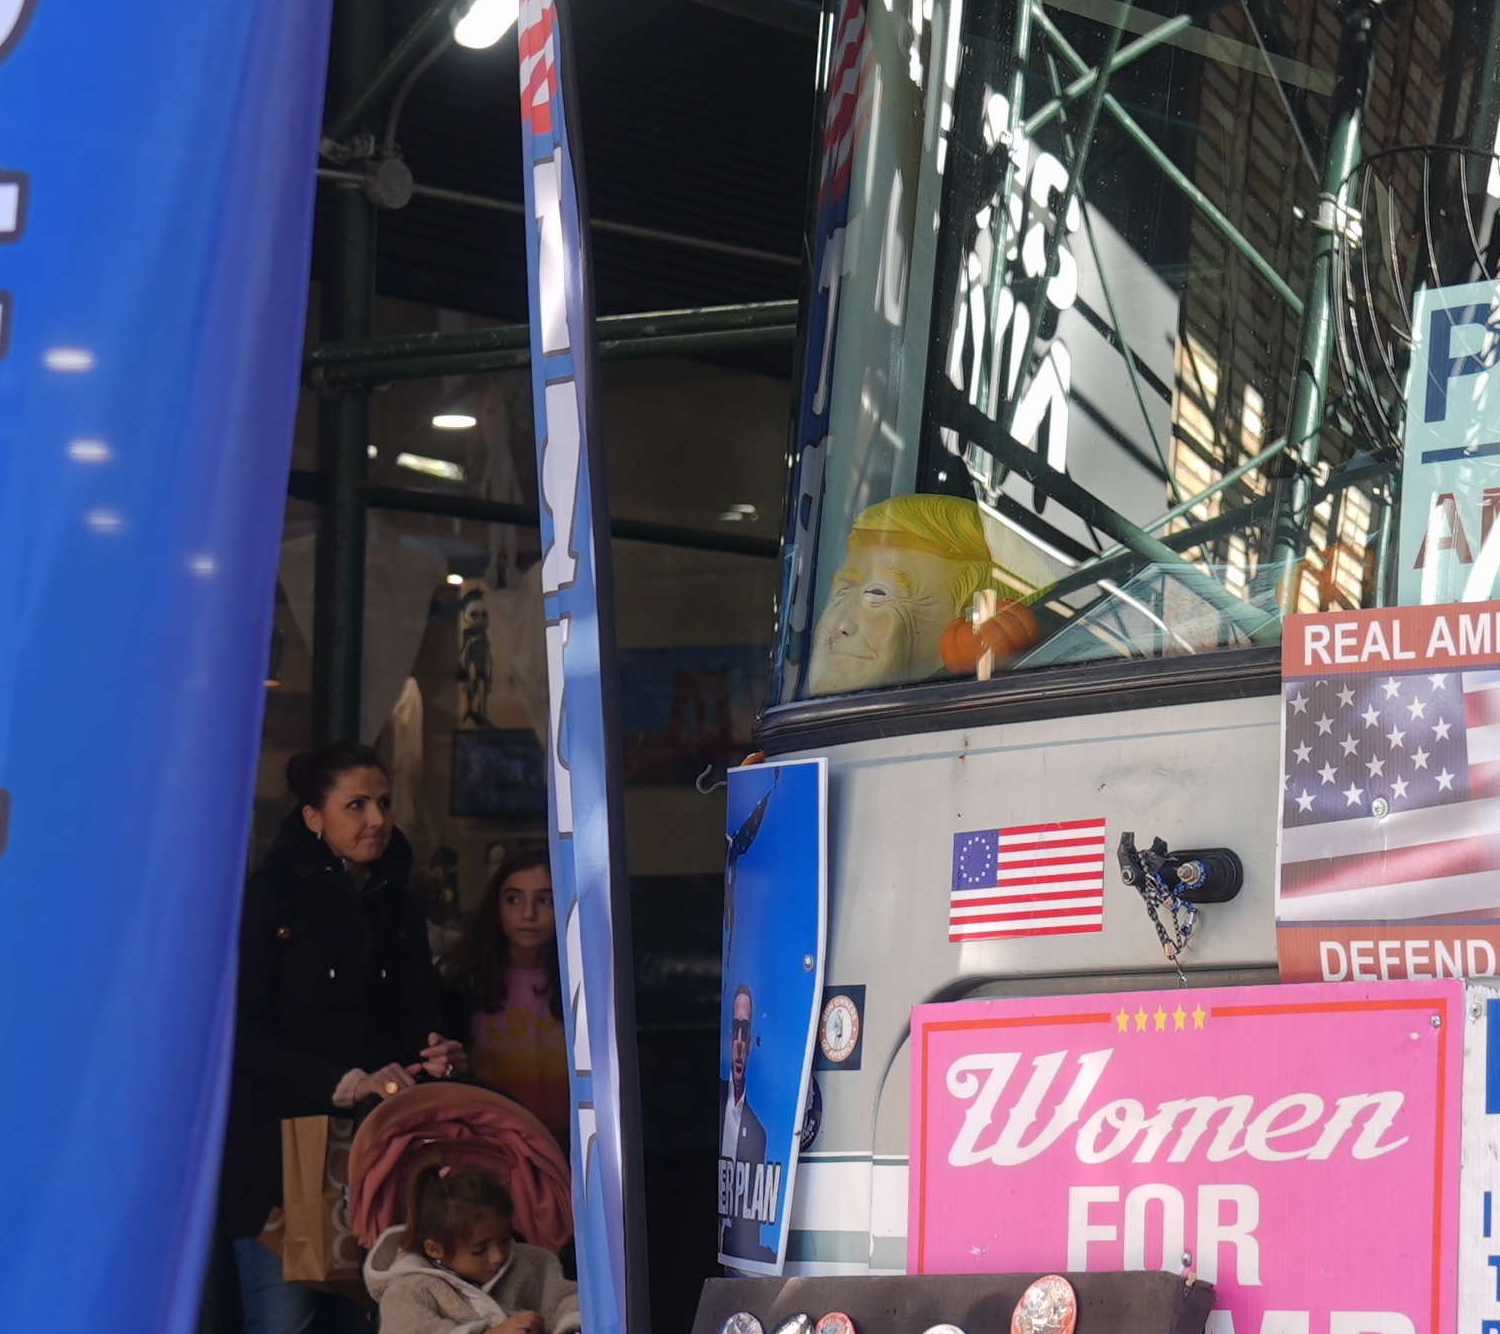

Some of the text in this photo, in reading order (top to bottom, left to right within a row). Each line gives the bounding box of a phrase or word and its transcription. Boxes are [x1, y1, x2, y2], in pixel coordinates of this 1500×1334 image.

[1302, 613, 1416, 665] REAL
[1319, 938, 1497, 983] DEFEND
[946, 1048, 1409, 1167] Women
[735, 1163, 782, 1223] PLAN
[1483, 1192, 1491, 1238] I
[1066, 1183, 1261, 1286] FOR
